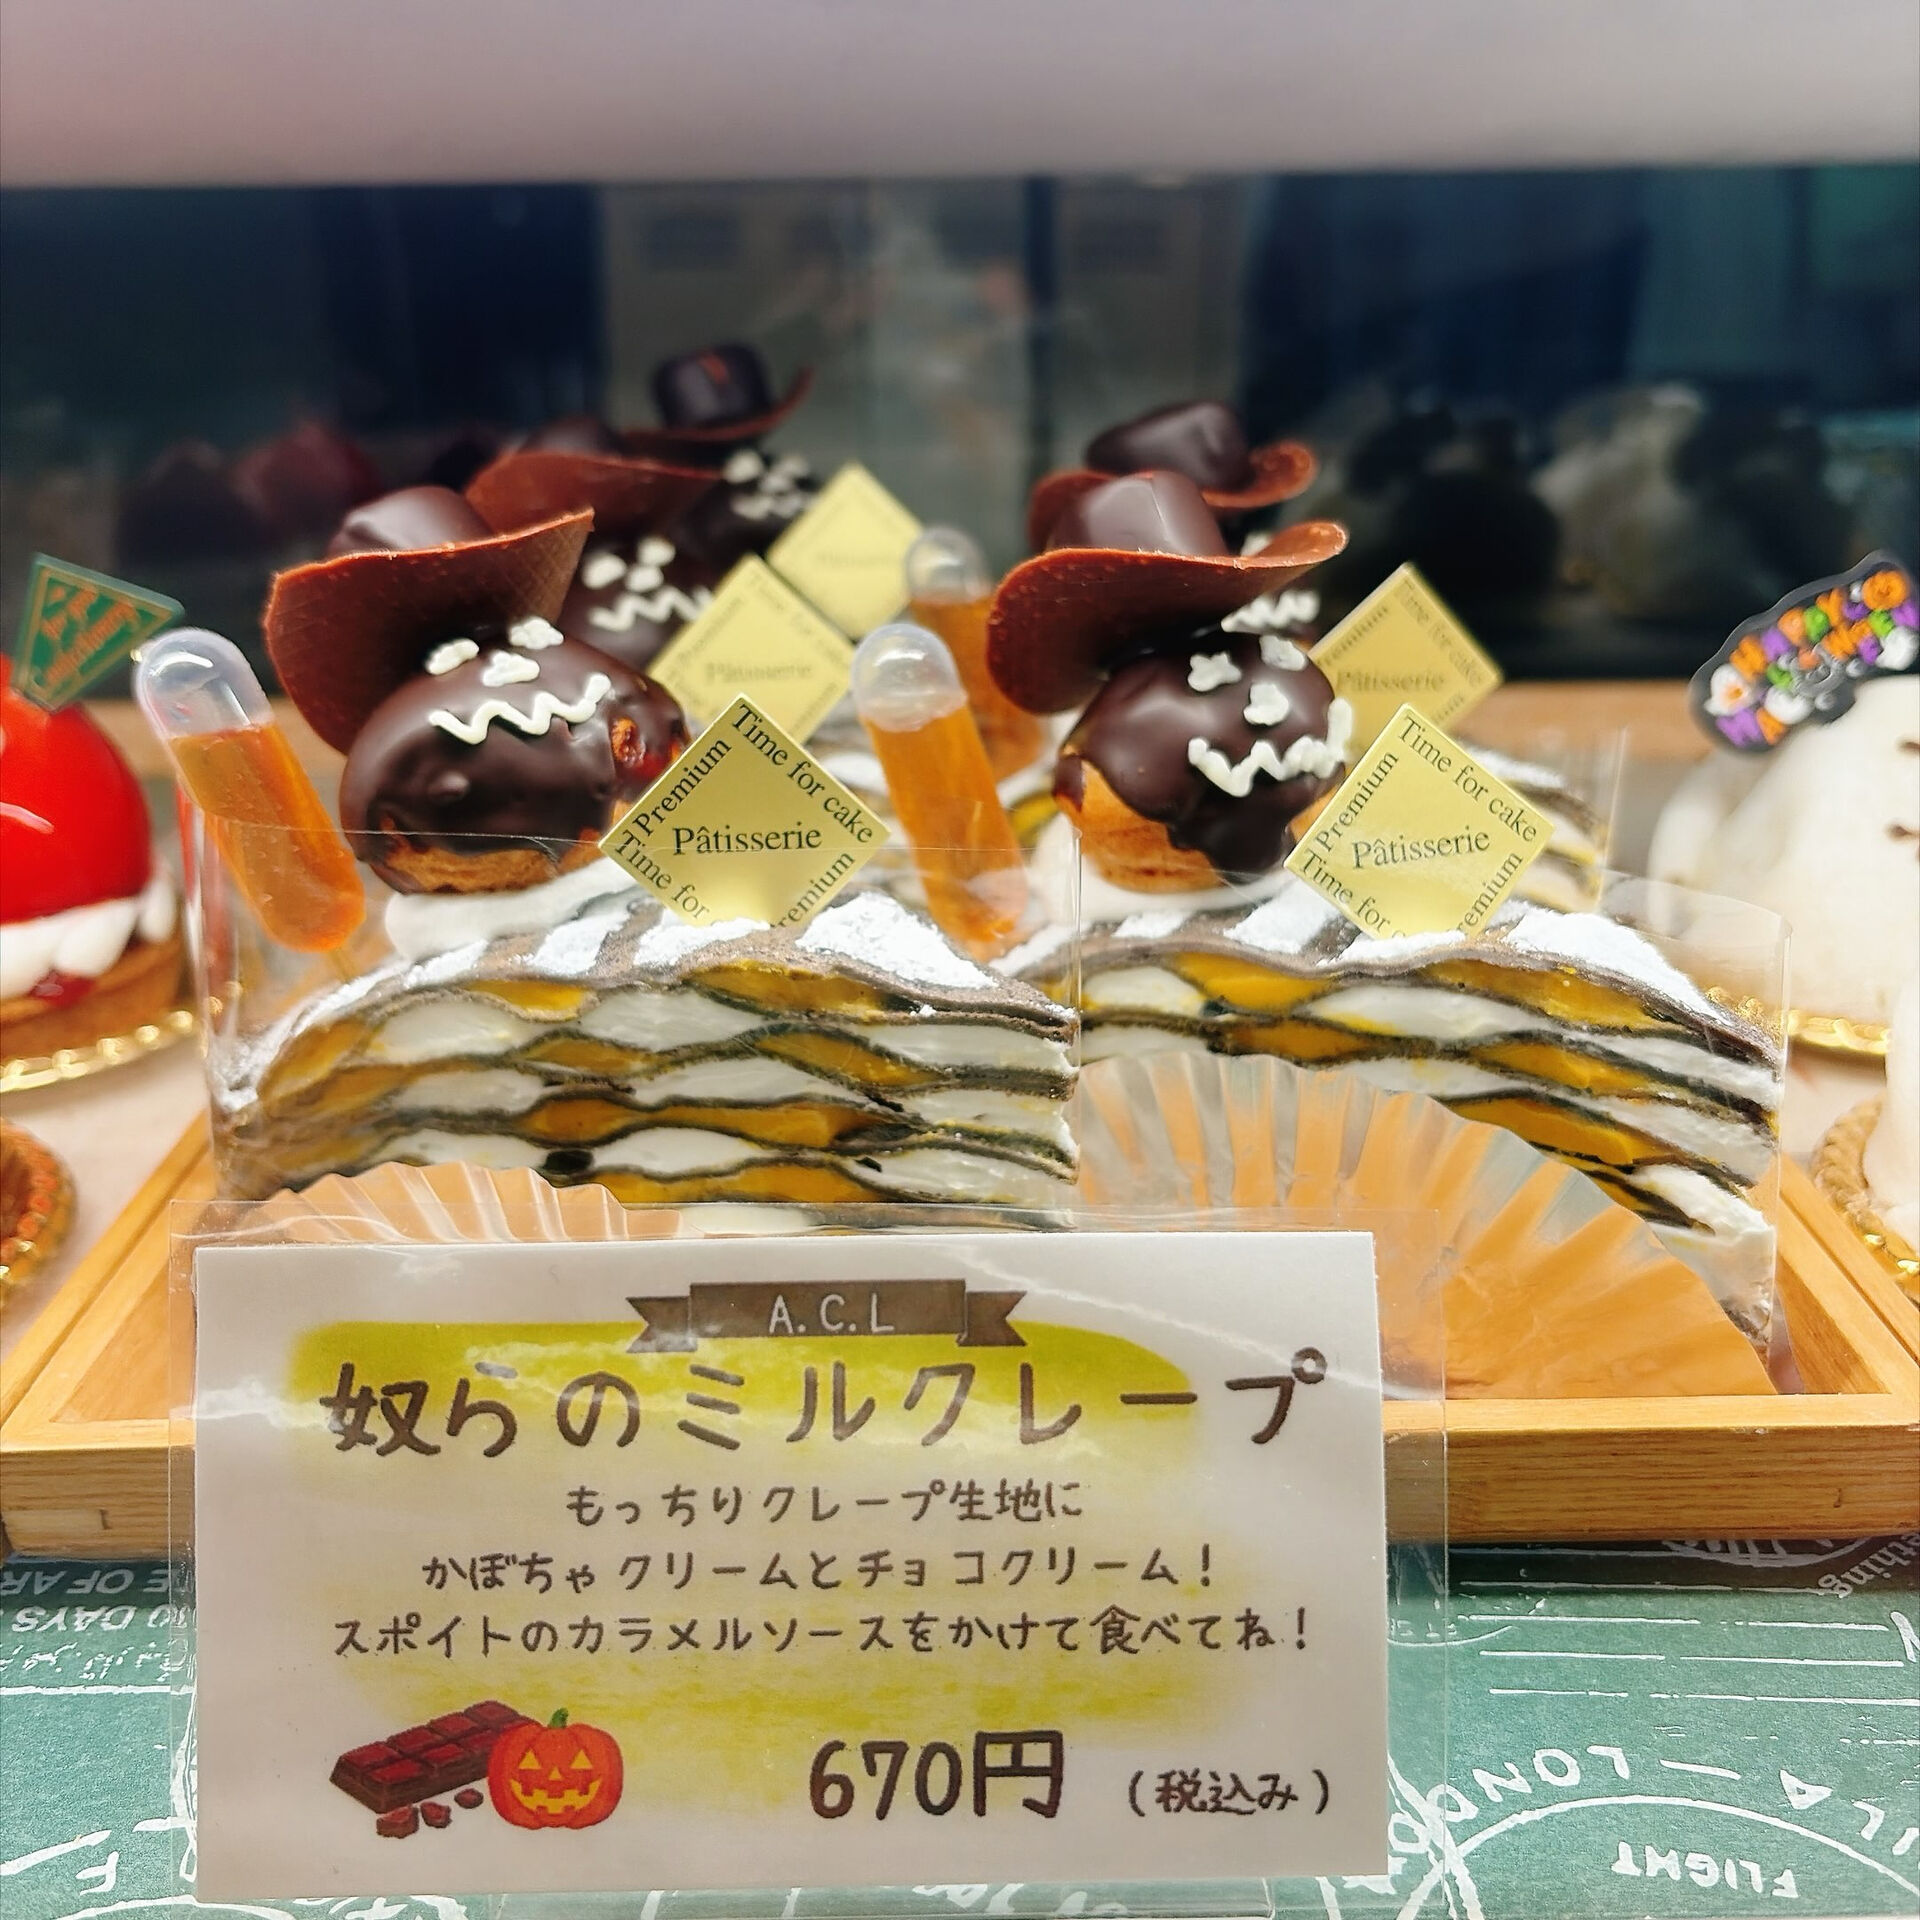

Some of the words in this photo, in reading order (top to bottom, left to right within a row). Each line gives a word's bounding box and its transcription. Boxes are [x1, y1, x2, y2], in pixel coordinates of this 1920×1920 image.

[632, 738, 732, 837] Premium
[732, 703, 788, 766] Time
[788, 761, 824, 798] for
[824, 796, 873, 843] cake
[1315, 751, 1399, 852] Premium
[1398, 716, 1452, 774] Time
[1453, 767, 1489, 801] for
[1489, 797, 1537, 843] cake
[615, 829, 672, 890] Time
[671, 884, 711, 920] for
[672, 821, 822, 856] Pâtisserie
[1352, 825, 1491, 869] Pâtisserie
[772, 852, 856, 928] remium
[1300, 849, 1353, 902] Time
[1354, 896, 1391, 933] for
[1458, 853, 1523, 932] remium
[769, 1293, 895, 1334] A.C.L
[319, 1346, 1327, 1457] 奴らのミルクレープ
[567, 1478, 1082, 1527] もっちりクレープ生地に
[12, 1605, 137, 1632] DAYS
[66, 1568, 135, 1595] OF
[809, 1730, 1064, 1821] 670円
[1128, 1768, 1329, 1817] （税込み）
[1610, 1841, 1800, 1898] FLIGHT
